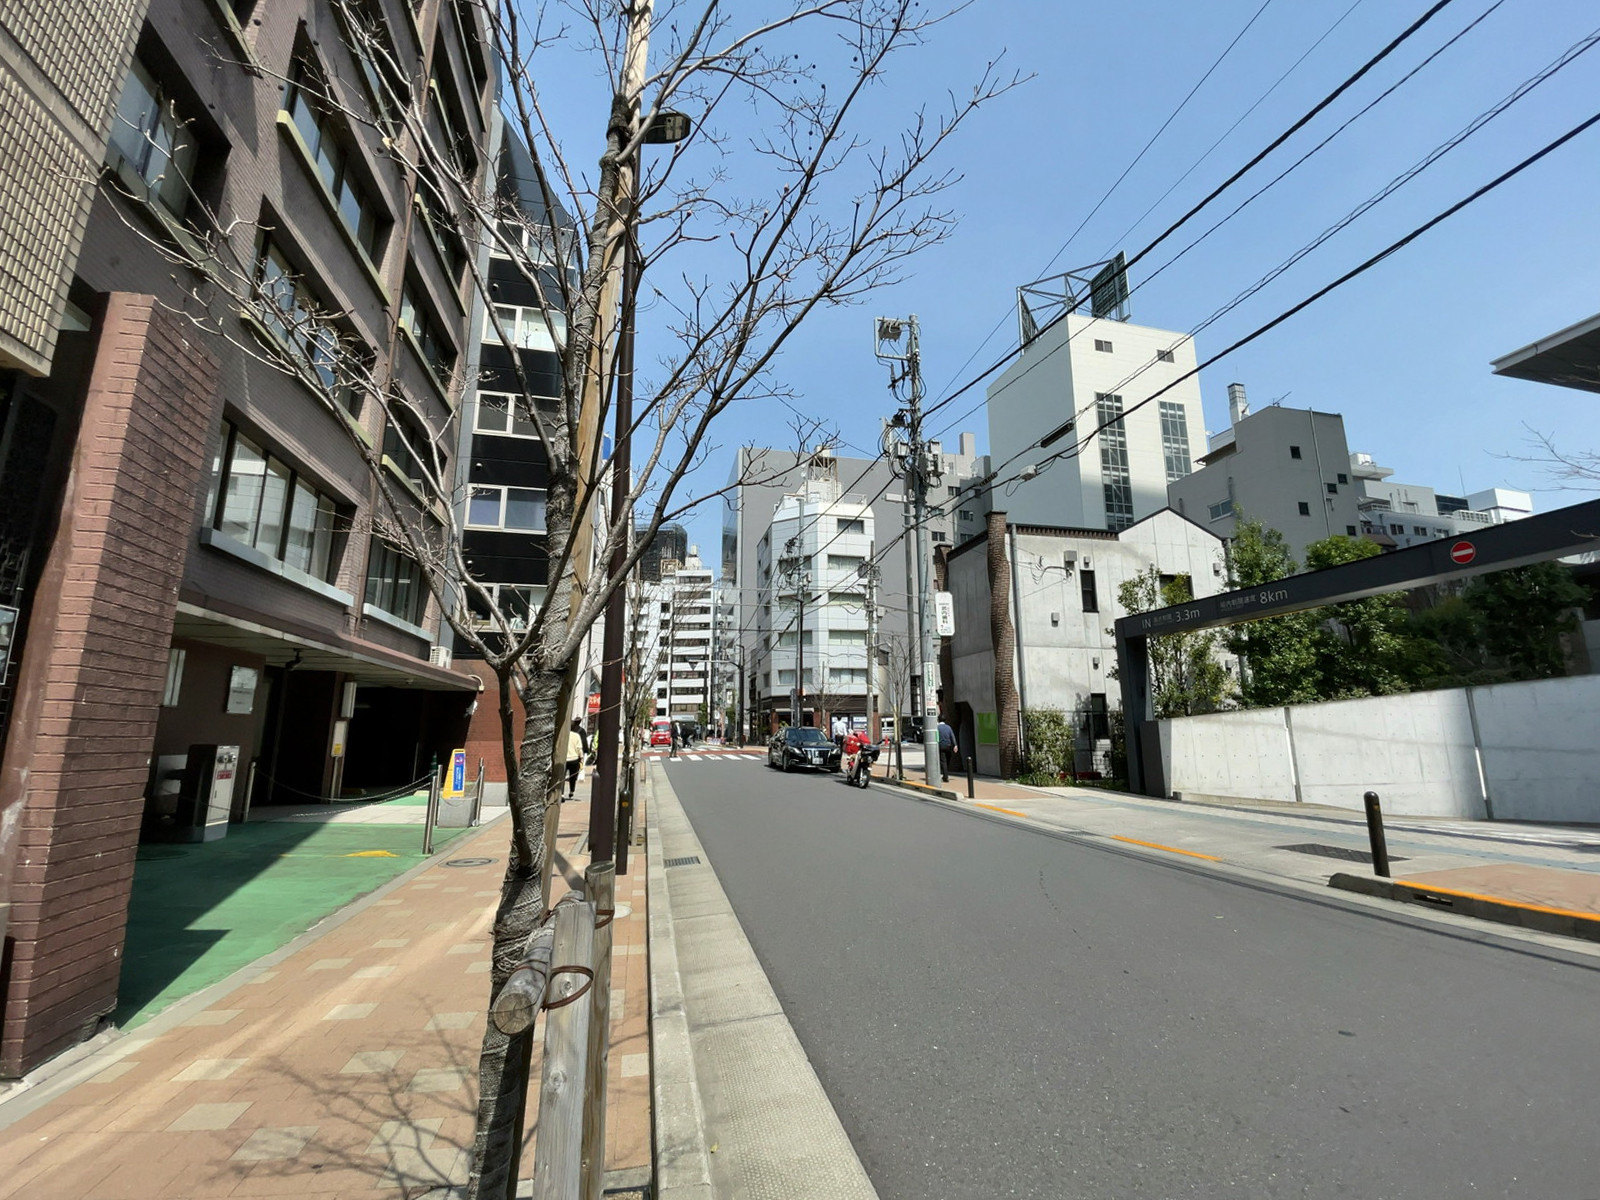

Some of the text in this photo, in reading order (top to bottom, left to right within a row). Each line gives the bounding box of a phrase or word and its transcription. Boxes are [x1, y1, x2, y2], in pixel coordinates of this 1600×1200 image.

[1260, 589, 1288, 604] 8km
[1141, 618, 1152, 629] IN
[1175, 609, 1200, 623] 3.3m
